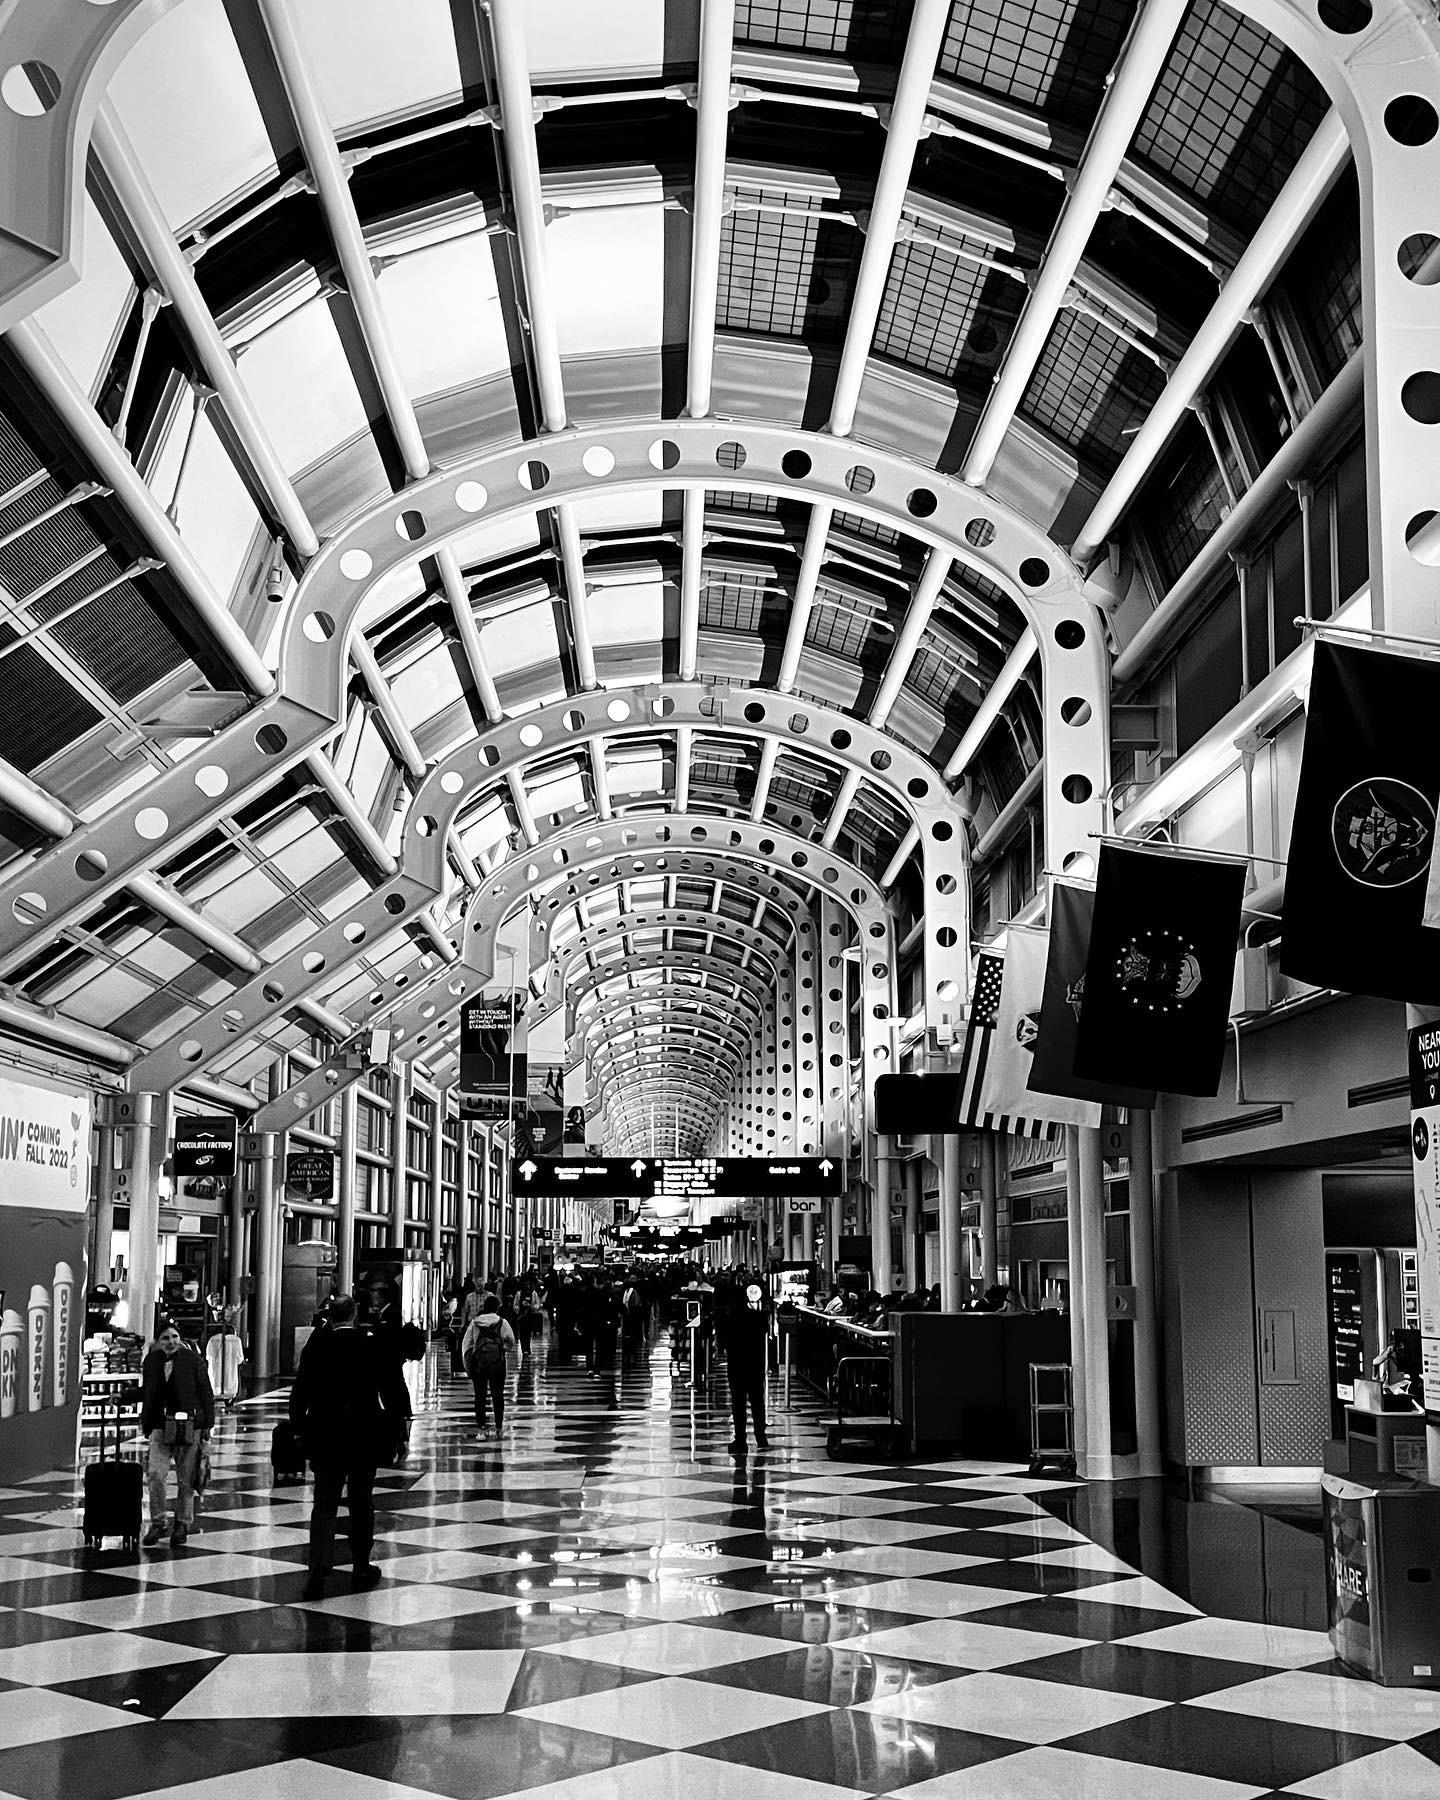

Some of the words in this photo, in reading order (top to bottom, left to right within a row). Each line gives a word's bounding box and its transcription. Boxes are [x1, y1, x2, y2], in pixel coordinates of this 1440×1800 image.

[1418, 1031, 1440, 1051] NEAR
[27, 1122, 61, 1146] COMING
[26, 1143, 45, 1165] FALL
[49, 1148, 68, 1168] 2022
[208, 1141, 232, 1150] FACTORY
[790, 1197, 816, 1211] bar
